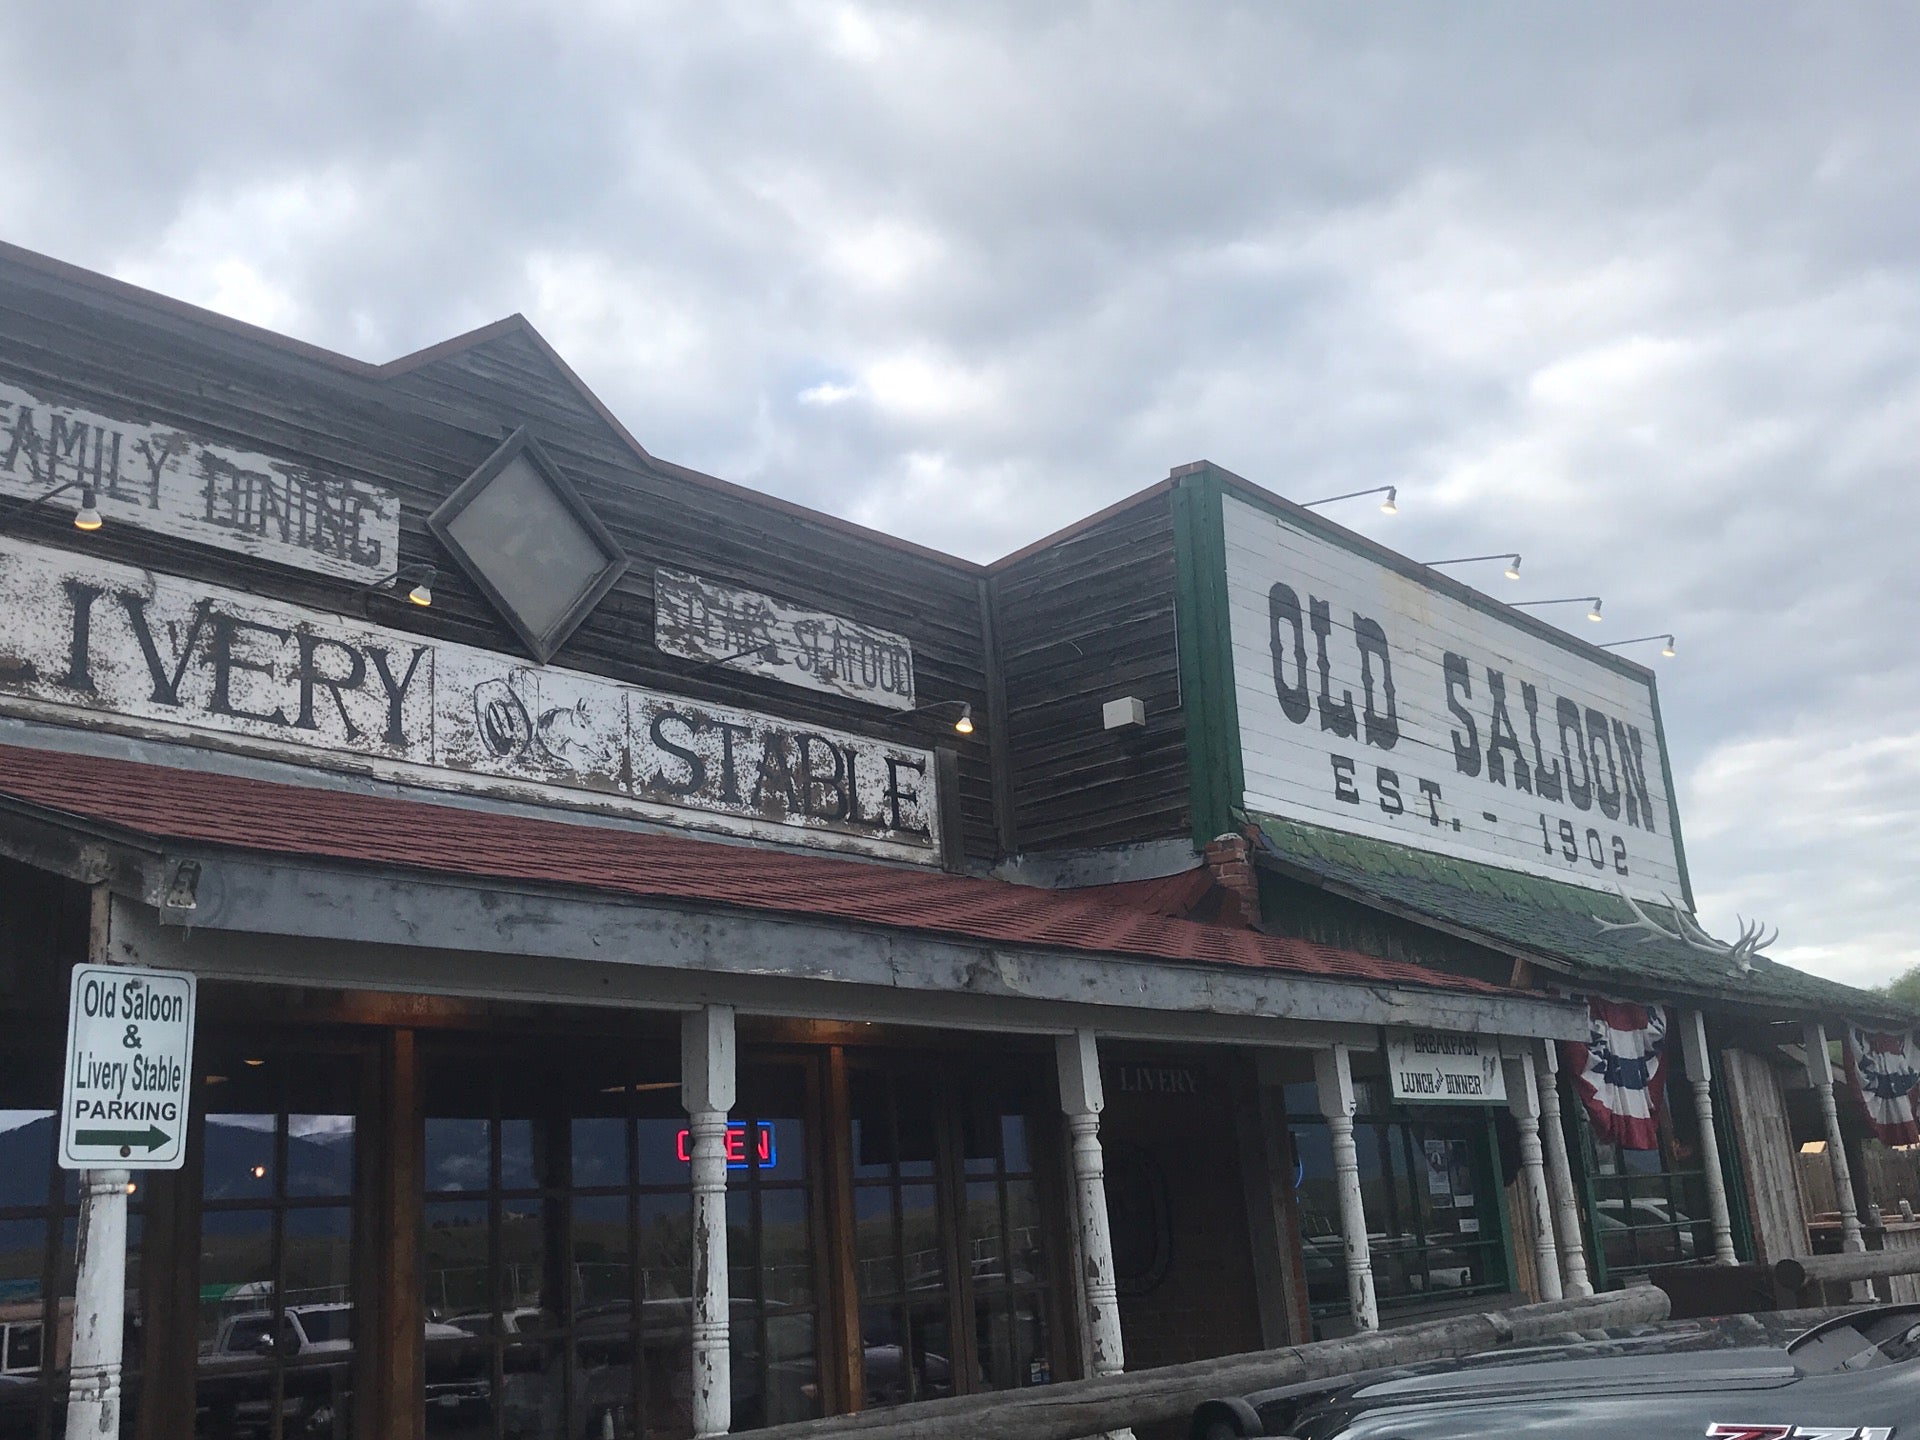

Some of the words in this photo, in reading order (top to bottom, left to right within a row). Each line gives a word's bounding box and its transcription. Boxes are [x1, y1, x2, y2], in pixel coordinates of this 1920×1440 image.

[1269, 582, 1398, 751] OLD
[1443, 651, 1656, 832] SALOON
[650, 710, 931, 842] STABLE
[1330, 754, 1460, 832] EST.
[1539, 814, 1629, 876] 1902
[84, 980, 117, 1018] Old
[121, 982, 182, 1022] Saloon
[123, 1024, 142, 1049] &
[76, 1051, 128, 1100] Livery
[132, 1053, 181, 1092] Stable
[1120, 1067, 1196, 1092] LIVERY
[1400, 1072, 1435, 1093] LUNCH
[1445, 1074, 1483, 1095] DINNER
[75, 1100, 177, 1121] PARKING
[677, 1130, 769, 1160] OEN
